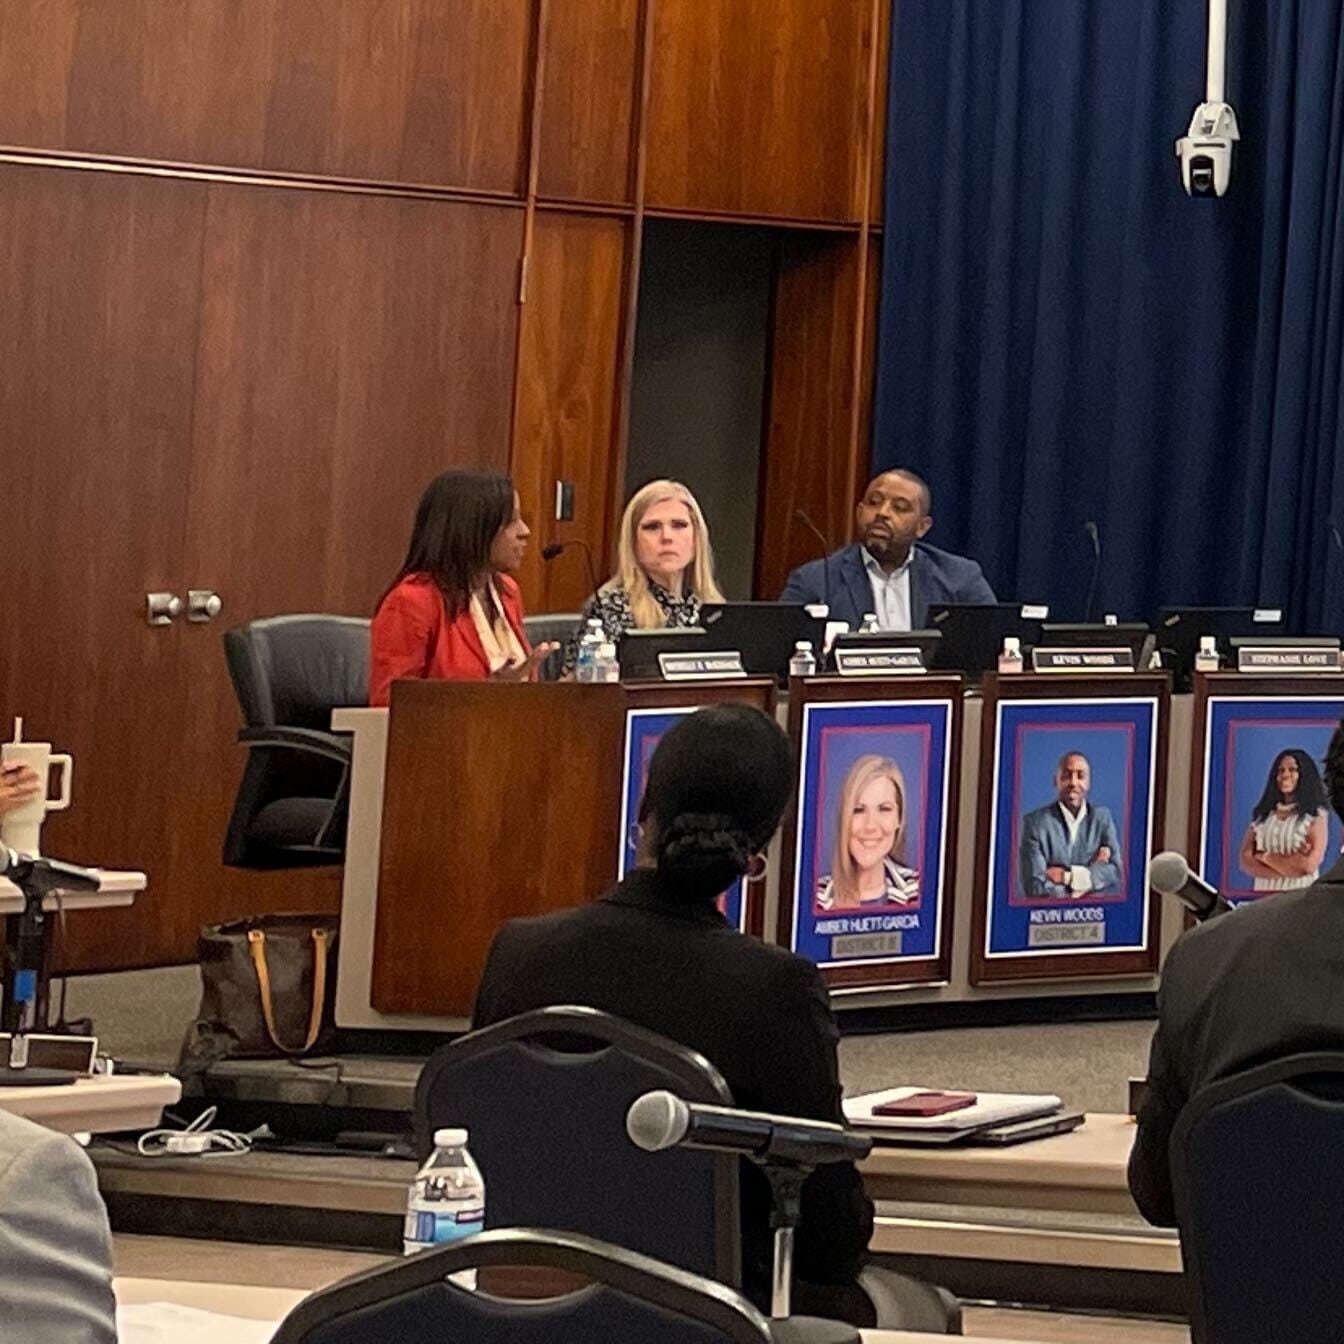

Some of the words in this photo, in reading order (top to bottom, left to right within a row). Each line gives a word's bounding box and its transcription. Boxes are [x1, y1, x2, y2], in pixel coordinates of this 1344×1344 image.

[1030, 908, 1062, 923] KEVIN
[1064, 906, 1105, 922] WOODS
[1034, 926, 1086, 942] DISTRICT
[1089, 925, 1099, 940] 4
